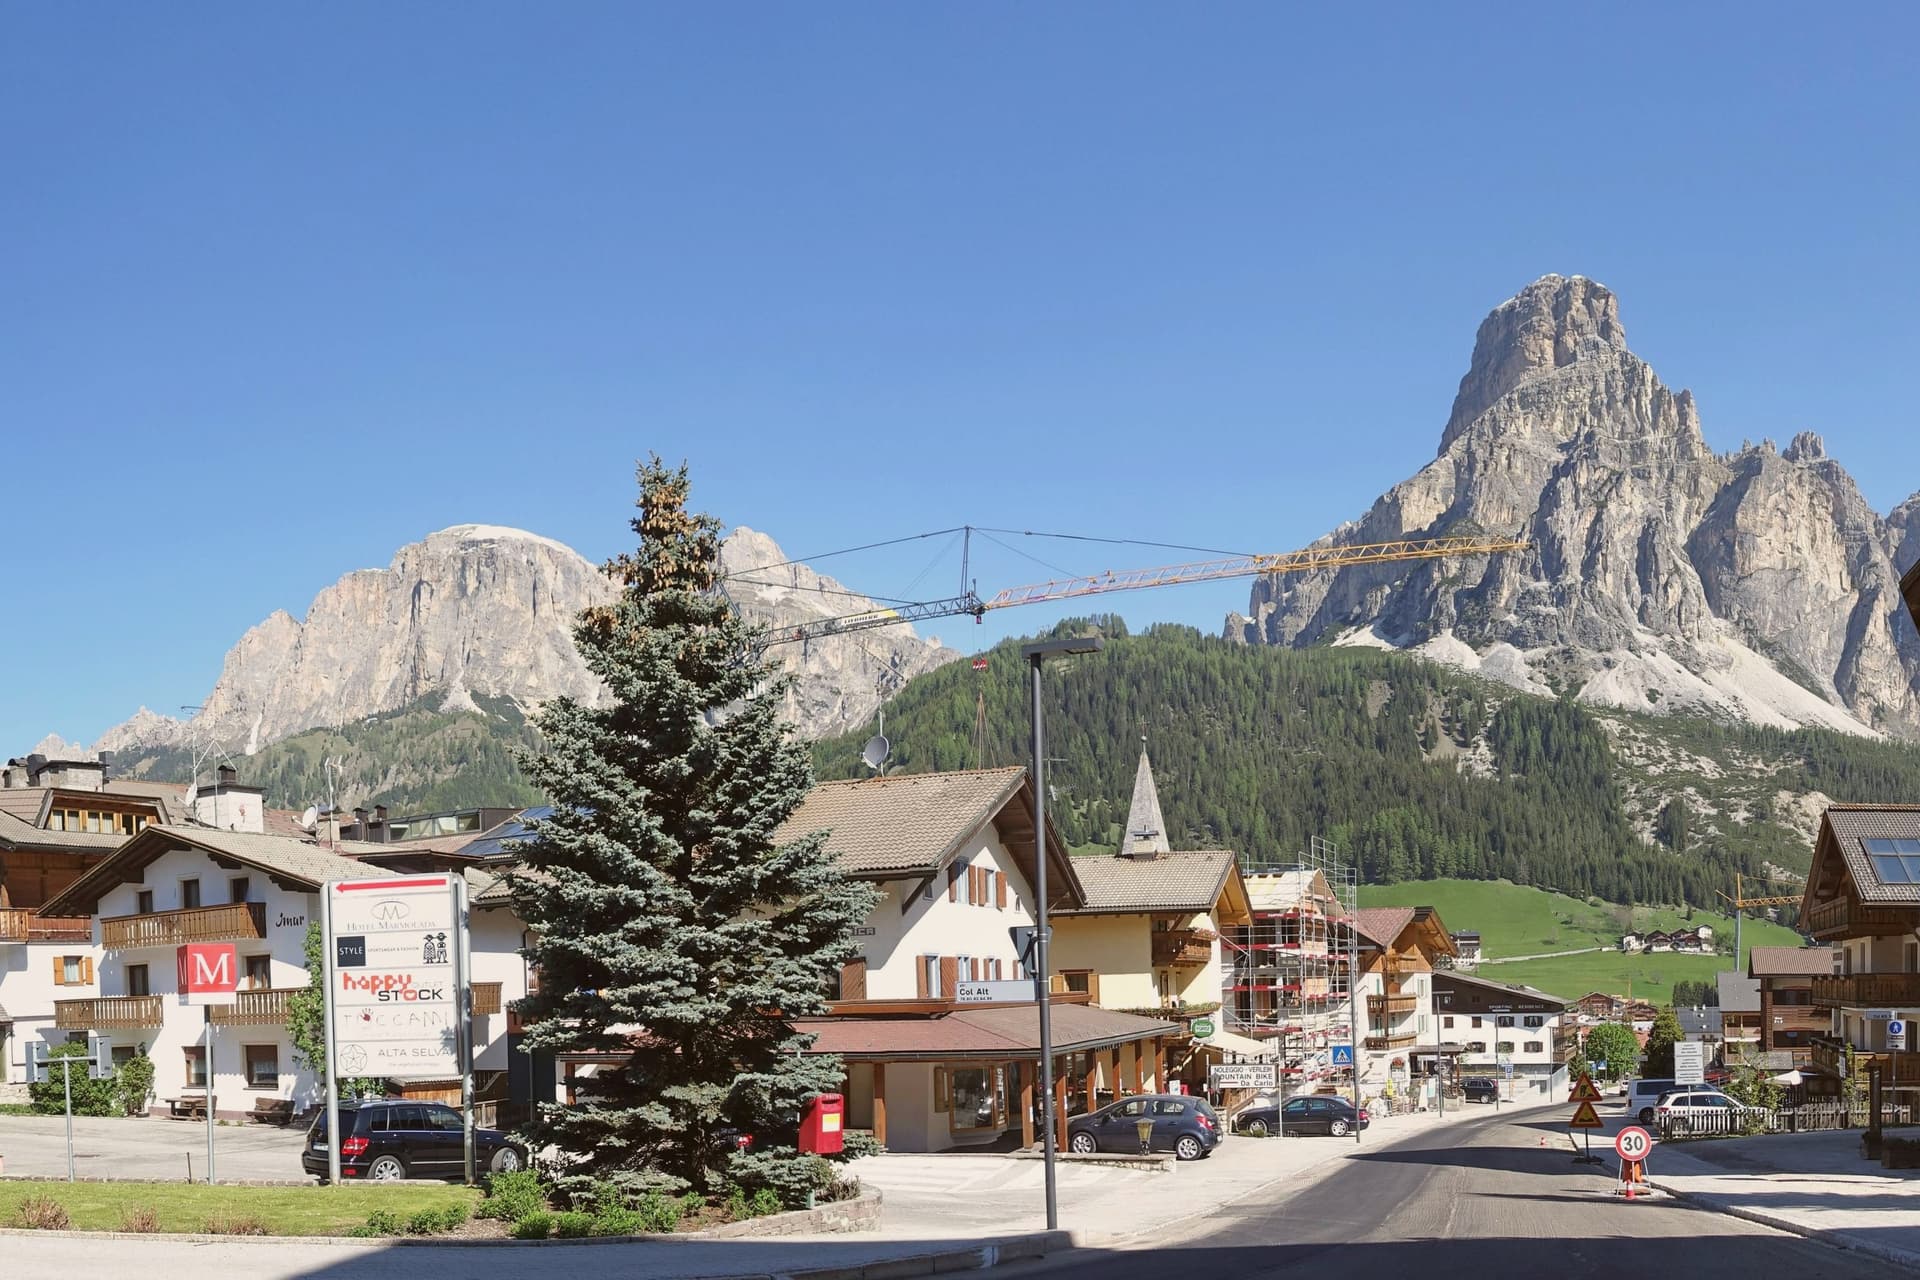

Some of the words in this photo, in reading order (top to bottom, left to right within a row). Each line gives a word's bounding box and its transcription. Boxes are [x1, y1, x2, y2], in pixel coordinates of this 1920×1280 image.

[339, 946, 364, 955] STYLE
[192, 953, 232, 985] M
[343, 972, 412, 995] happy
[378, 989, 443, 1001] STOCK
[960, 988, 973, 996] Col
[976, 988, 989, 996] Alt
[378, 1048, 407, 1057] ALTA
[411, 1047, 450, 1057] SELVA
[1623, 1135, 1643, 1152] 30
